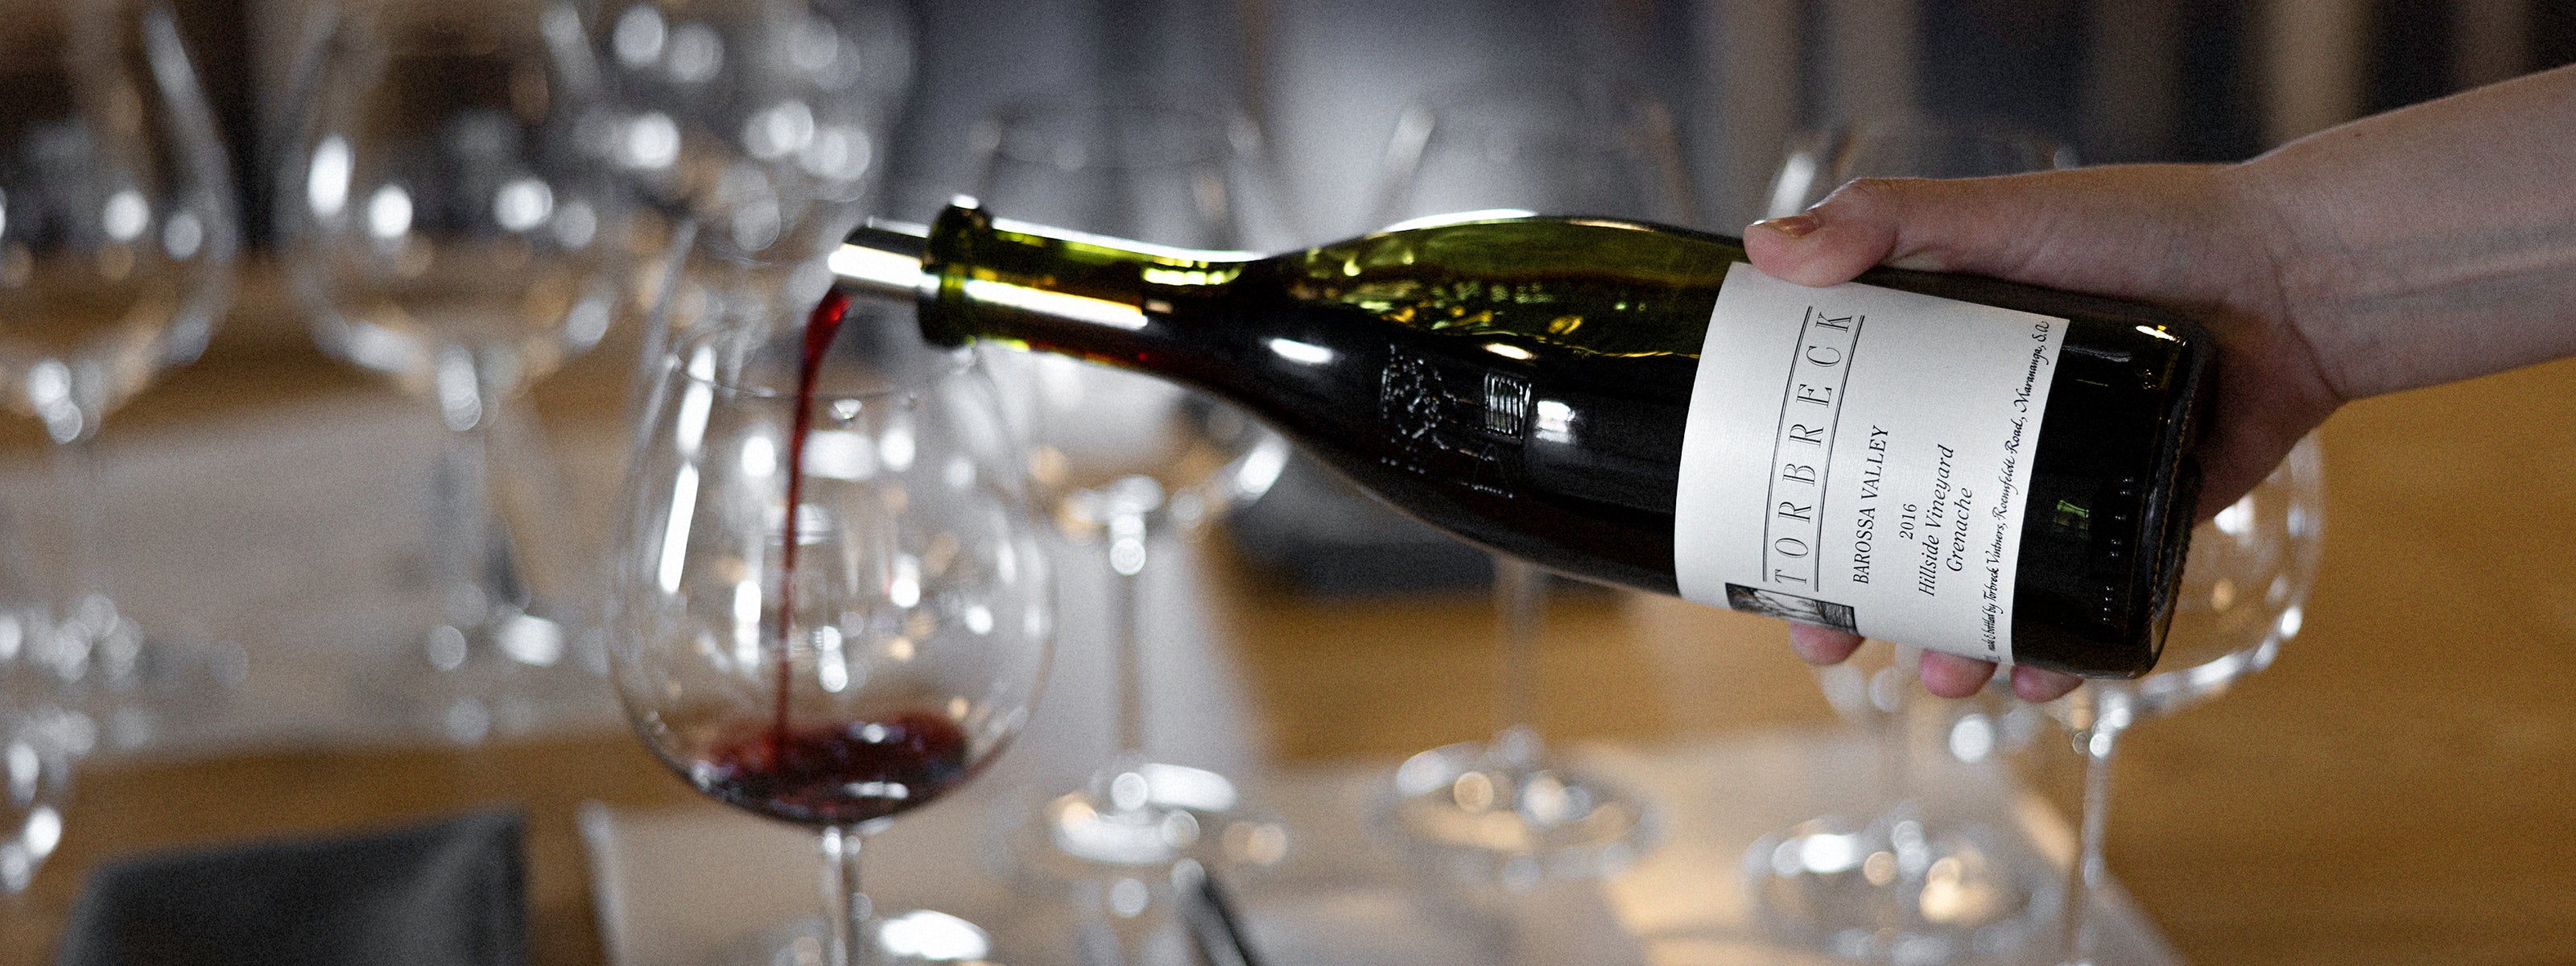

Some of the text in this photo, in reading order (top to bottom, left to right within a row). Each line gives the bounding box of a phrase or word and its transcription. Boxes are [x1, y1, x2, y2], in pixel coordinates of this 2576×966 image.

[2013, 345, 2049, 413] Marananga,
[1775, 312, 1852, 584] TORBRECK
[2004, 416, 2028, 454] Road,
[1853, 425, 1889, 584] BAROSSA VALLEY
[1992, 455, 2018, 520] Roennfeldt
[1899, 503, 1918, 540] 2016
[1918, 444, 1954, 597] Hillside Vineyard
[1946, 487, 1972, 572] Grenache
[1985, 522, 2008, 564] Vintners,
[1983, 603, 2004, 613] by
[1984, 566, 2000, 602] Torbreck
[1982, 613, 1996, 634] bottled
